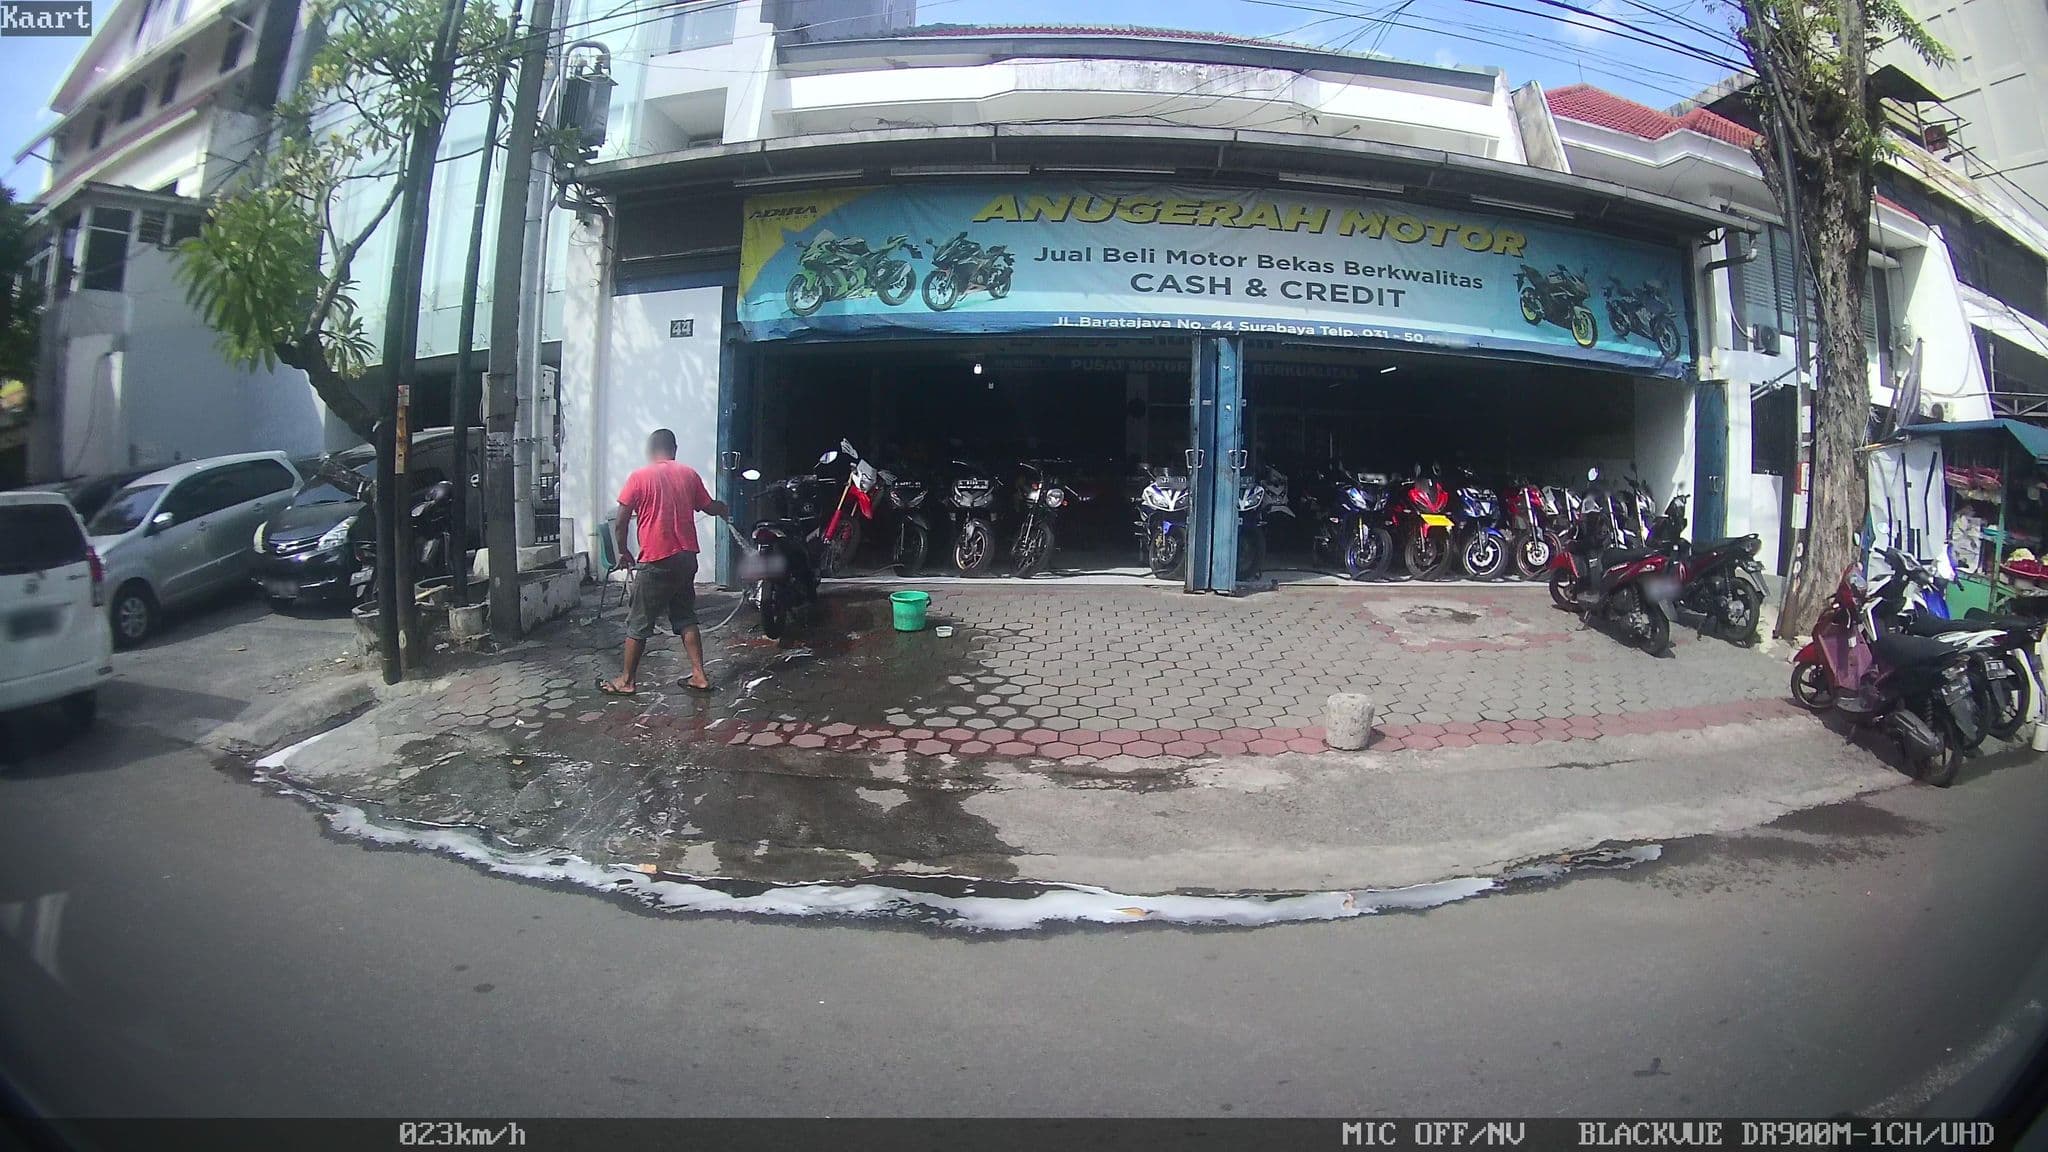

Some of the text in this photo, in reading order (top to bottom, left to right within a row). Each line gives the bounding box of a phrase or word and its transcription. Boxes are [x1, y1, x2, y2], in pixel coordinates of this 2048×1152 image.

[972, 195, 1527, 258] ANUGERAH MOTOR
[1034, 247, 1483, 289] Jual Beli Motor Bekas Berkwalitas
[1130, 273, 1406, 308] CASH & CREDIT
[672, 321, 692, 335] 44
[1177, 319, 1205, 330] No.
[1211, 320, 1234, 331] 44
[1239, 321, 1315, 335] Surabaya
[1320, 325, 1359, 337] Telp.
